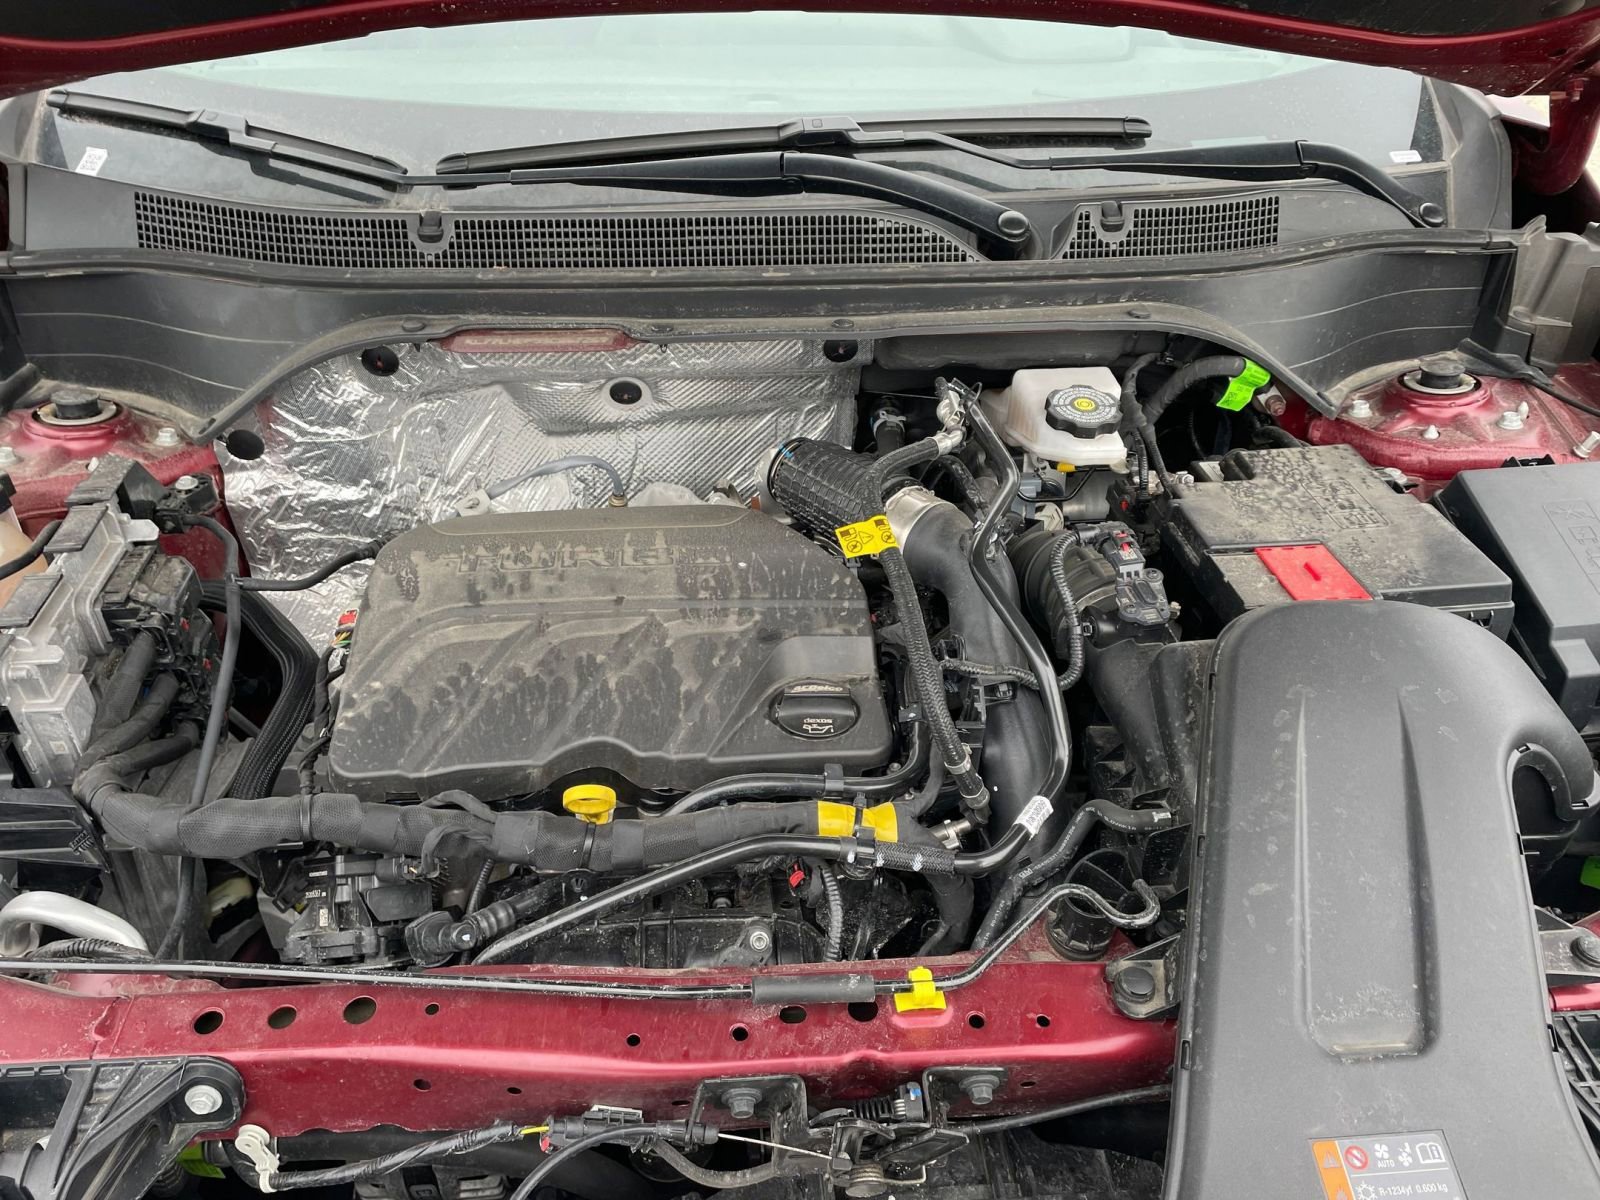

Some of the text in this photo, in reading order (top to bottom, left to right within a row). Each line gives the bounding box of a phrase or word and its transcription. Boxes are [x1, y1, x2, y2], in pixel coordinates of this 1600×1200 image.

[791, 685, 843, 693] ACDelco
[1377, 1160, 1395, 1168] AUTO
[1416, 1183, 1436, 1193] 0.600
[1437, 1182, 1449, 1193] kg
